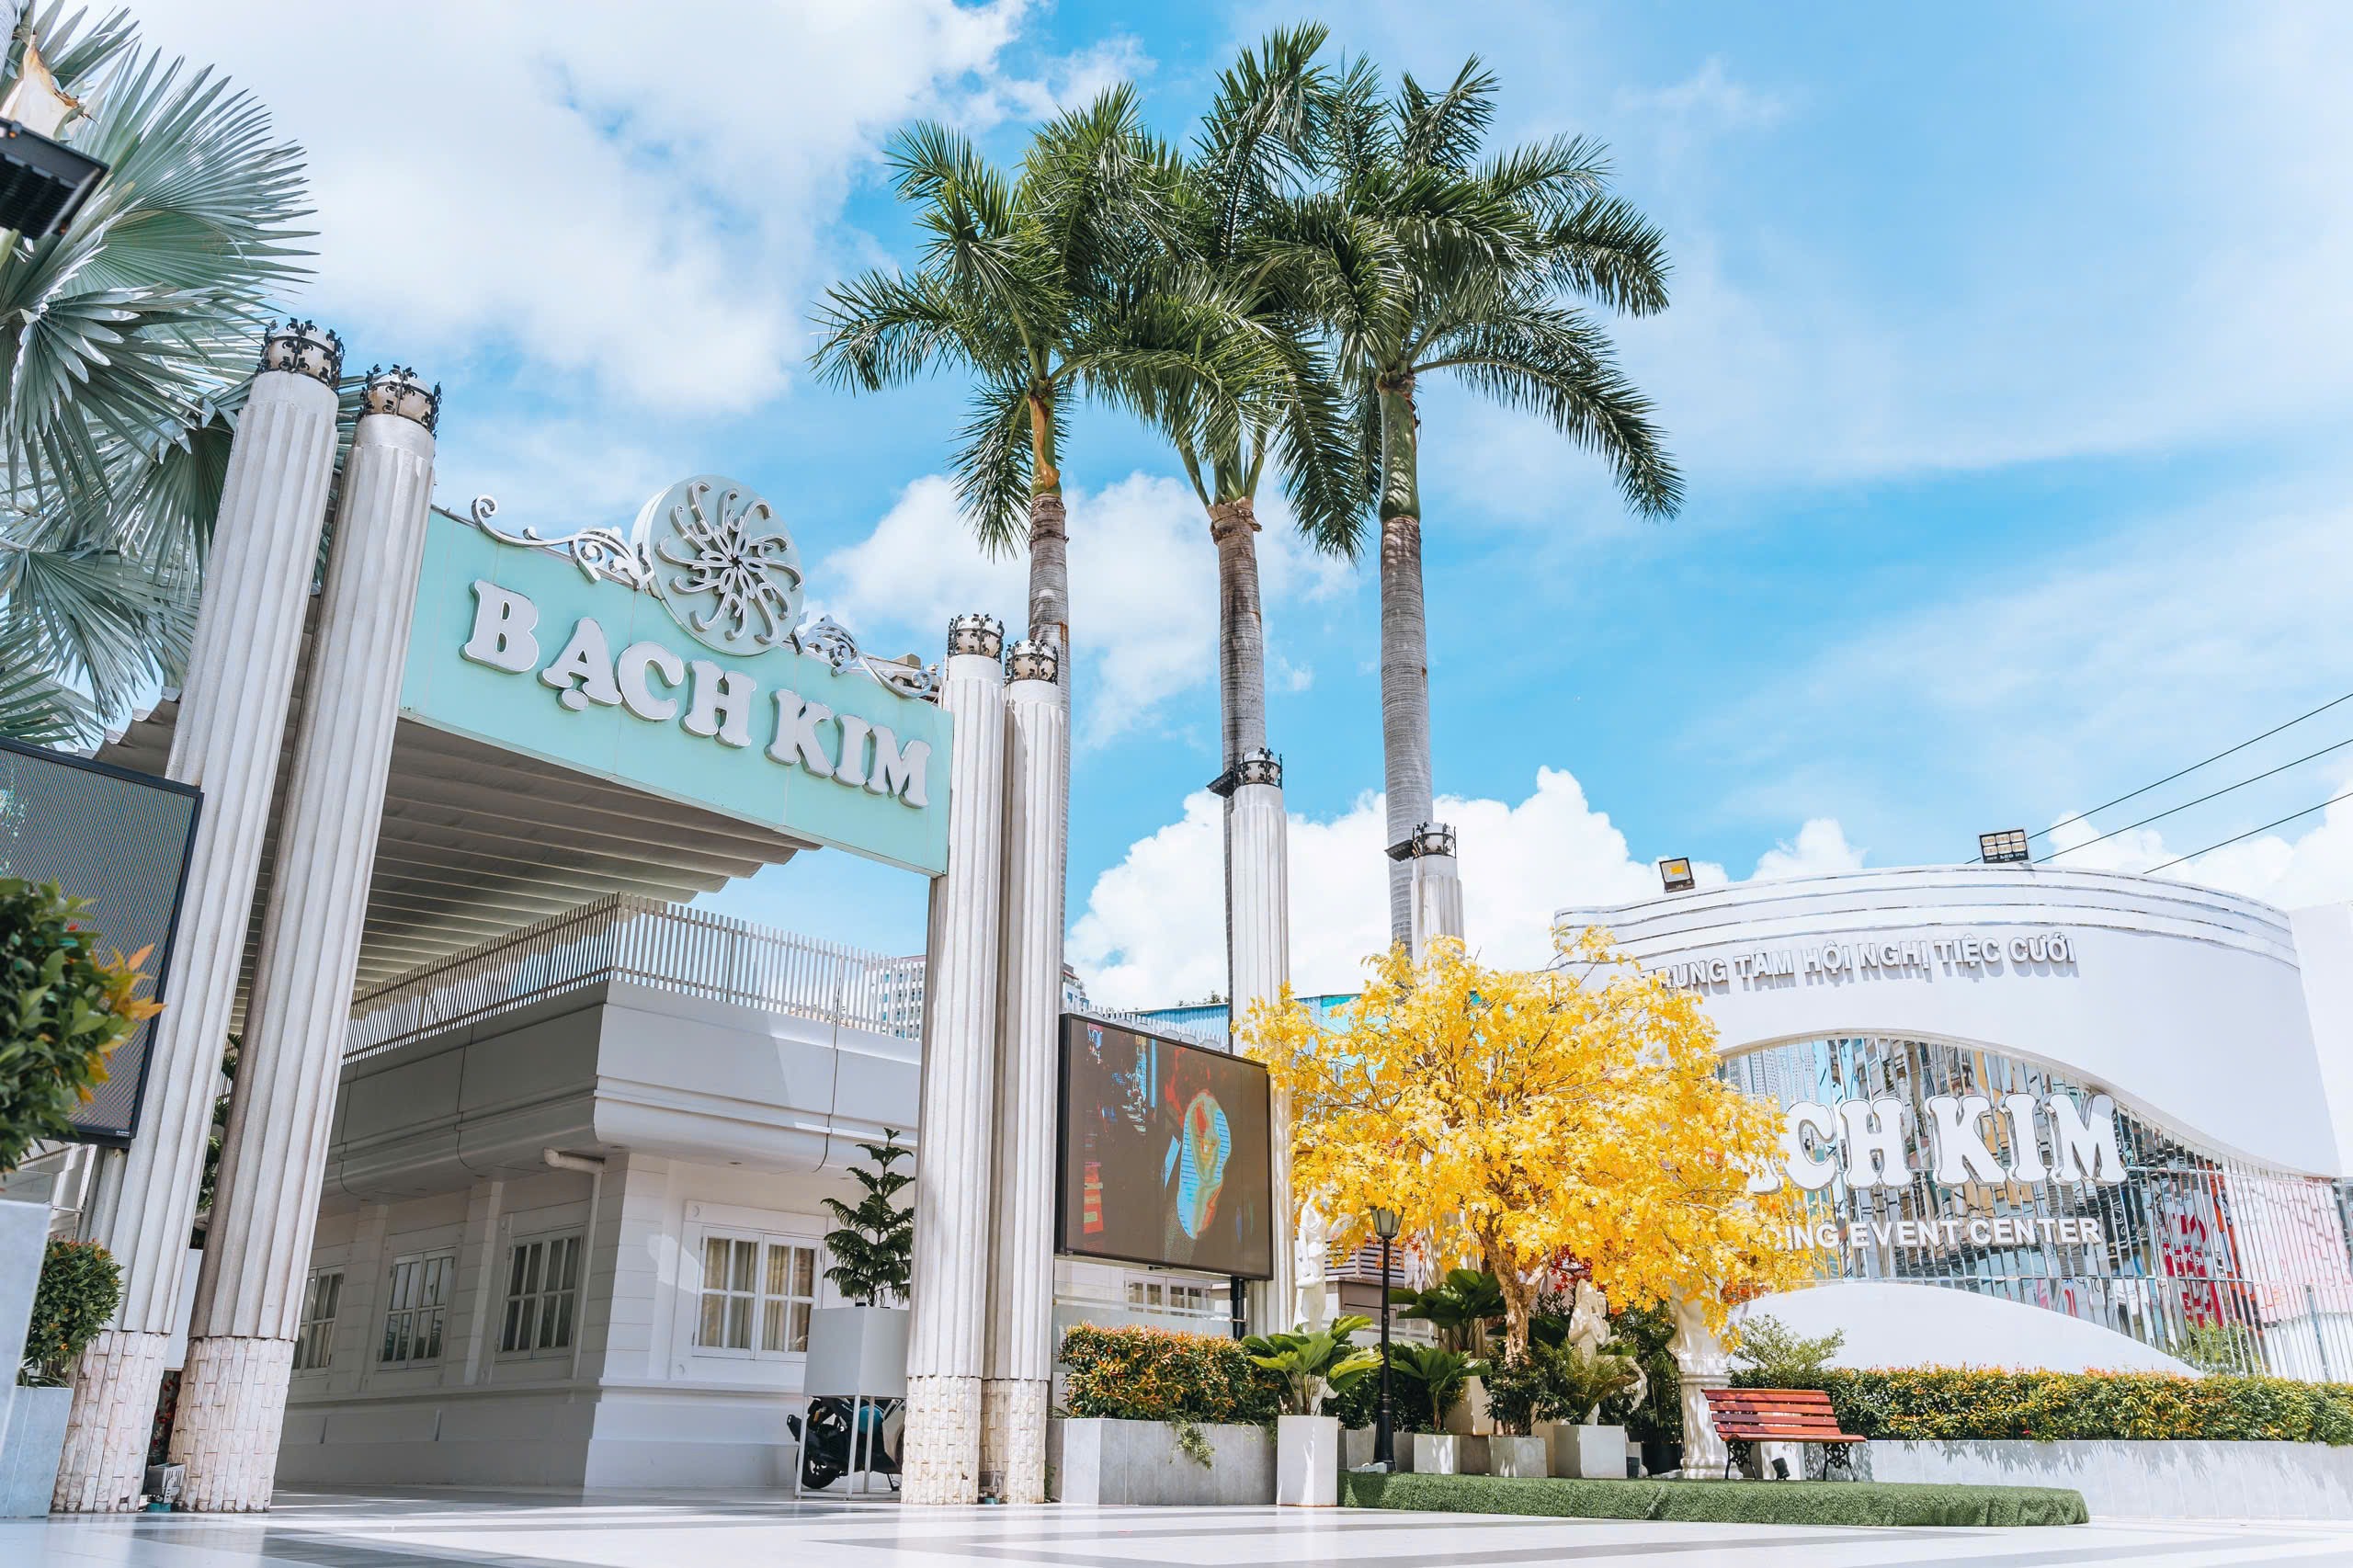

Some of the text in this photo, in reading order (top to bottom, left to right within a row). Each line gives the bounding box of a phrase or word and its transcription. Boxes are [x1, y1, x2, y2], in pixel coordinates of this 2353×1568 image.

[459, 579, 933, 809] BẠCH KIM
[1733, 949, 1795, 979] TÂM
[1801, 940, 1852, 974] HỘI
[1858, 940, 1929, 971] NGHỊ
[1934, 933, 2001, 969] TIỆC
[2008, 932, 2076, 963] CƯỚI
[1725, 1092, 2128, 1194] CH KIM
[1848, 1220, 1959, 1247] EVENT
[1969, 1218, 2103, 1245] CENTER
